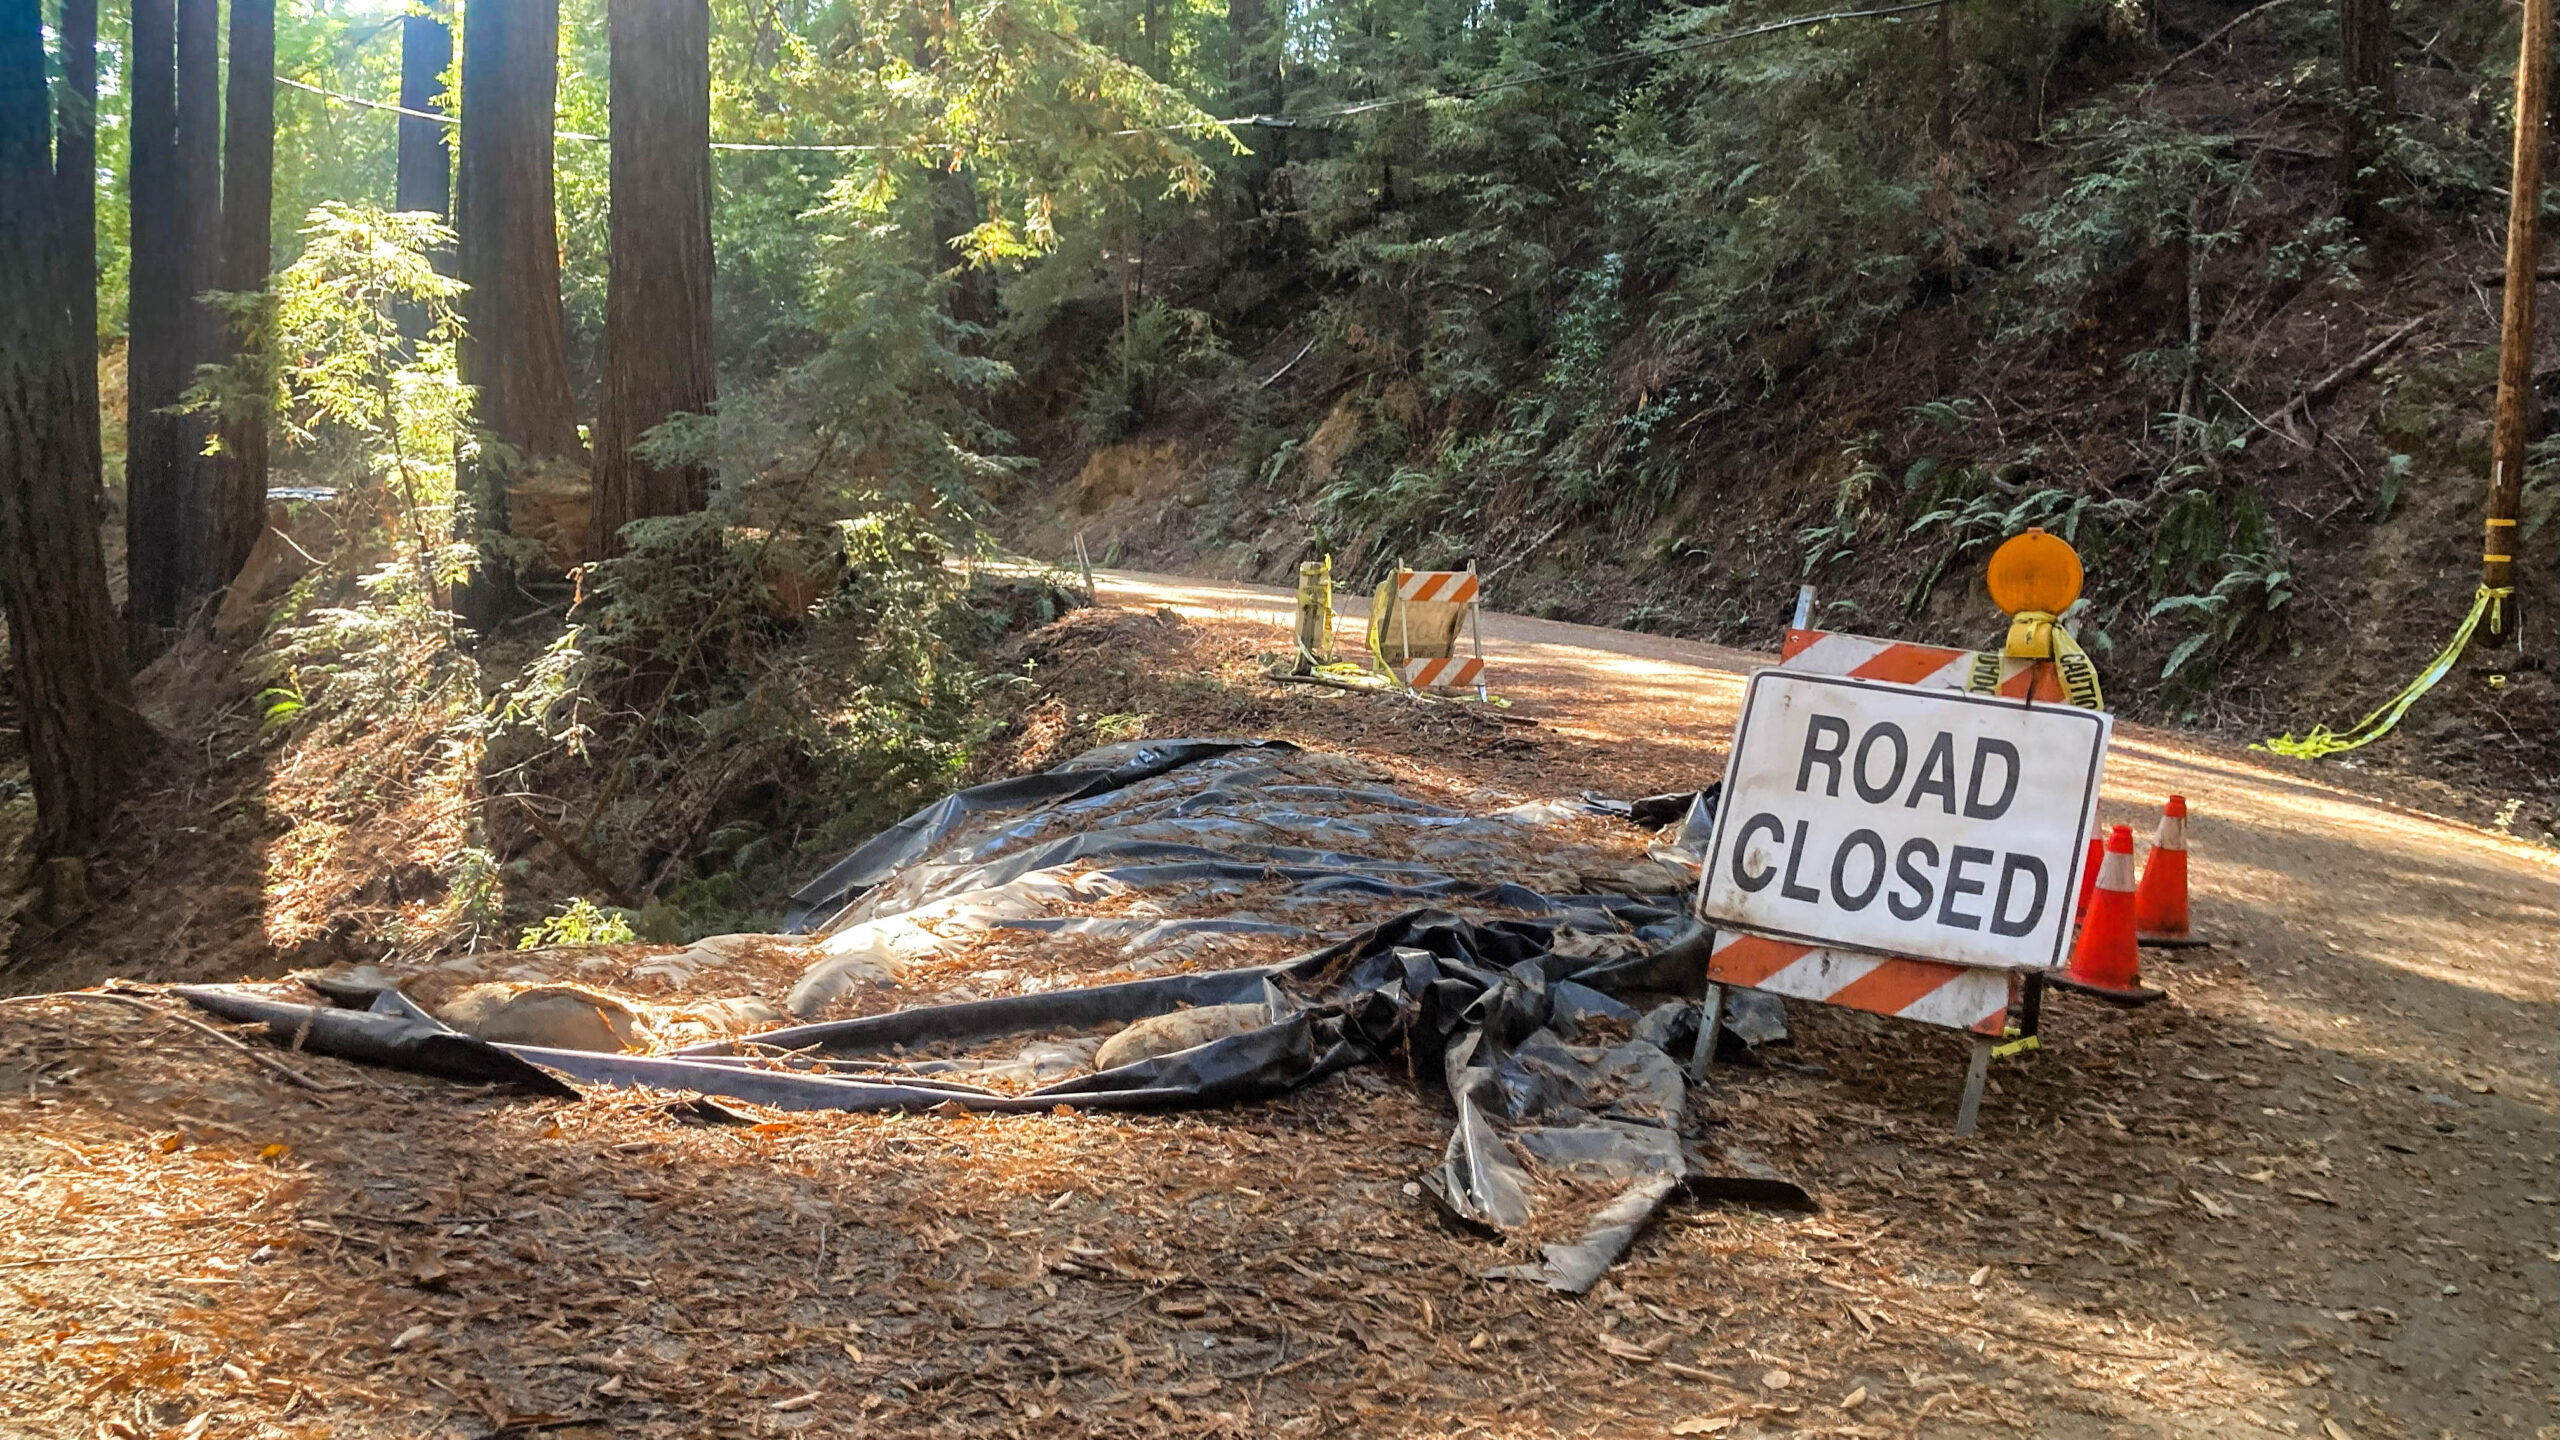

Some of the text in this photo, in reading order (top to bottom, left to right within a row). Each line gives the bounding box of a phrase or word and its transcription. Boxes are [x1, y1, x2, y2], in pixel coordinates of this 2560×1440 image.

[2060, 654, 2098, 709] CAUTIO
[1795, 713, 2020, 821] ROAD
[1731, 812, 2049, 938] CLOSED
